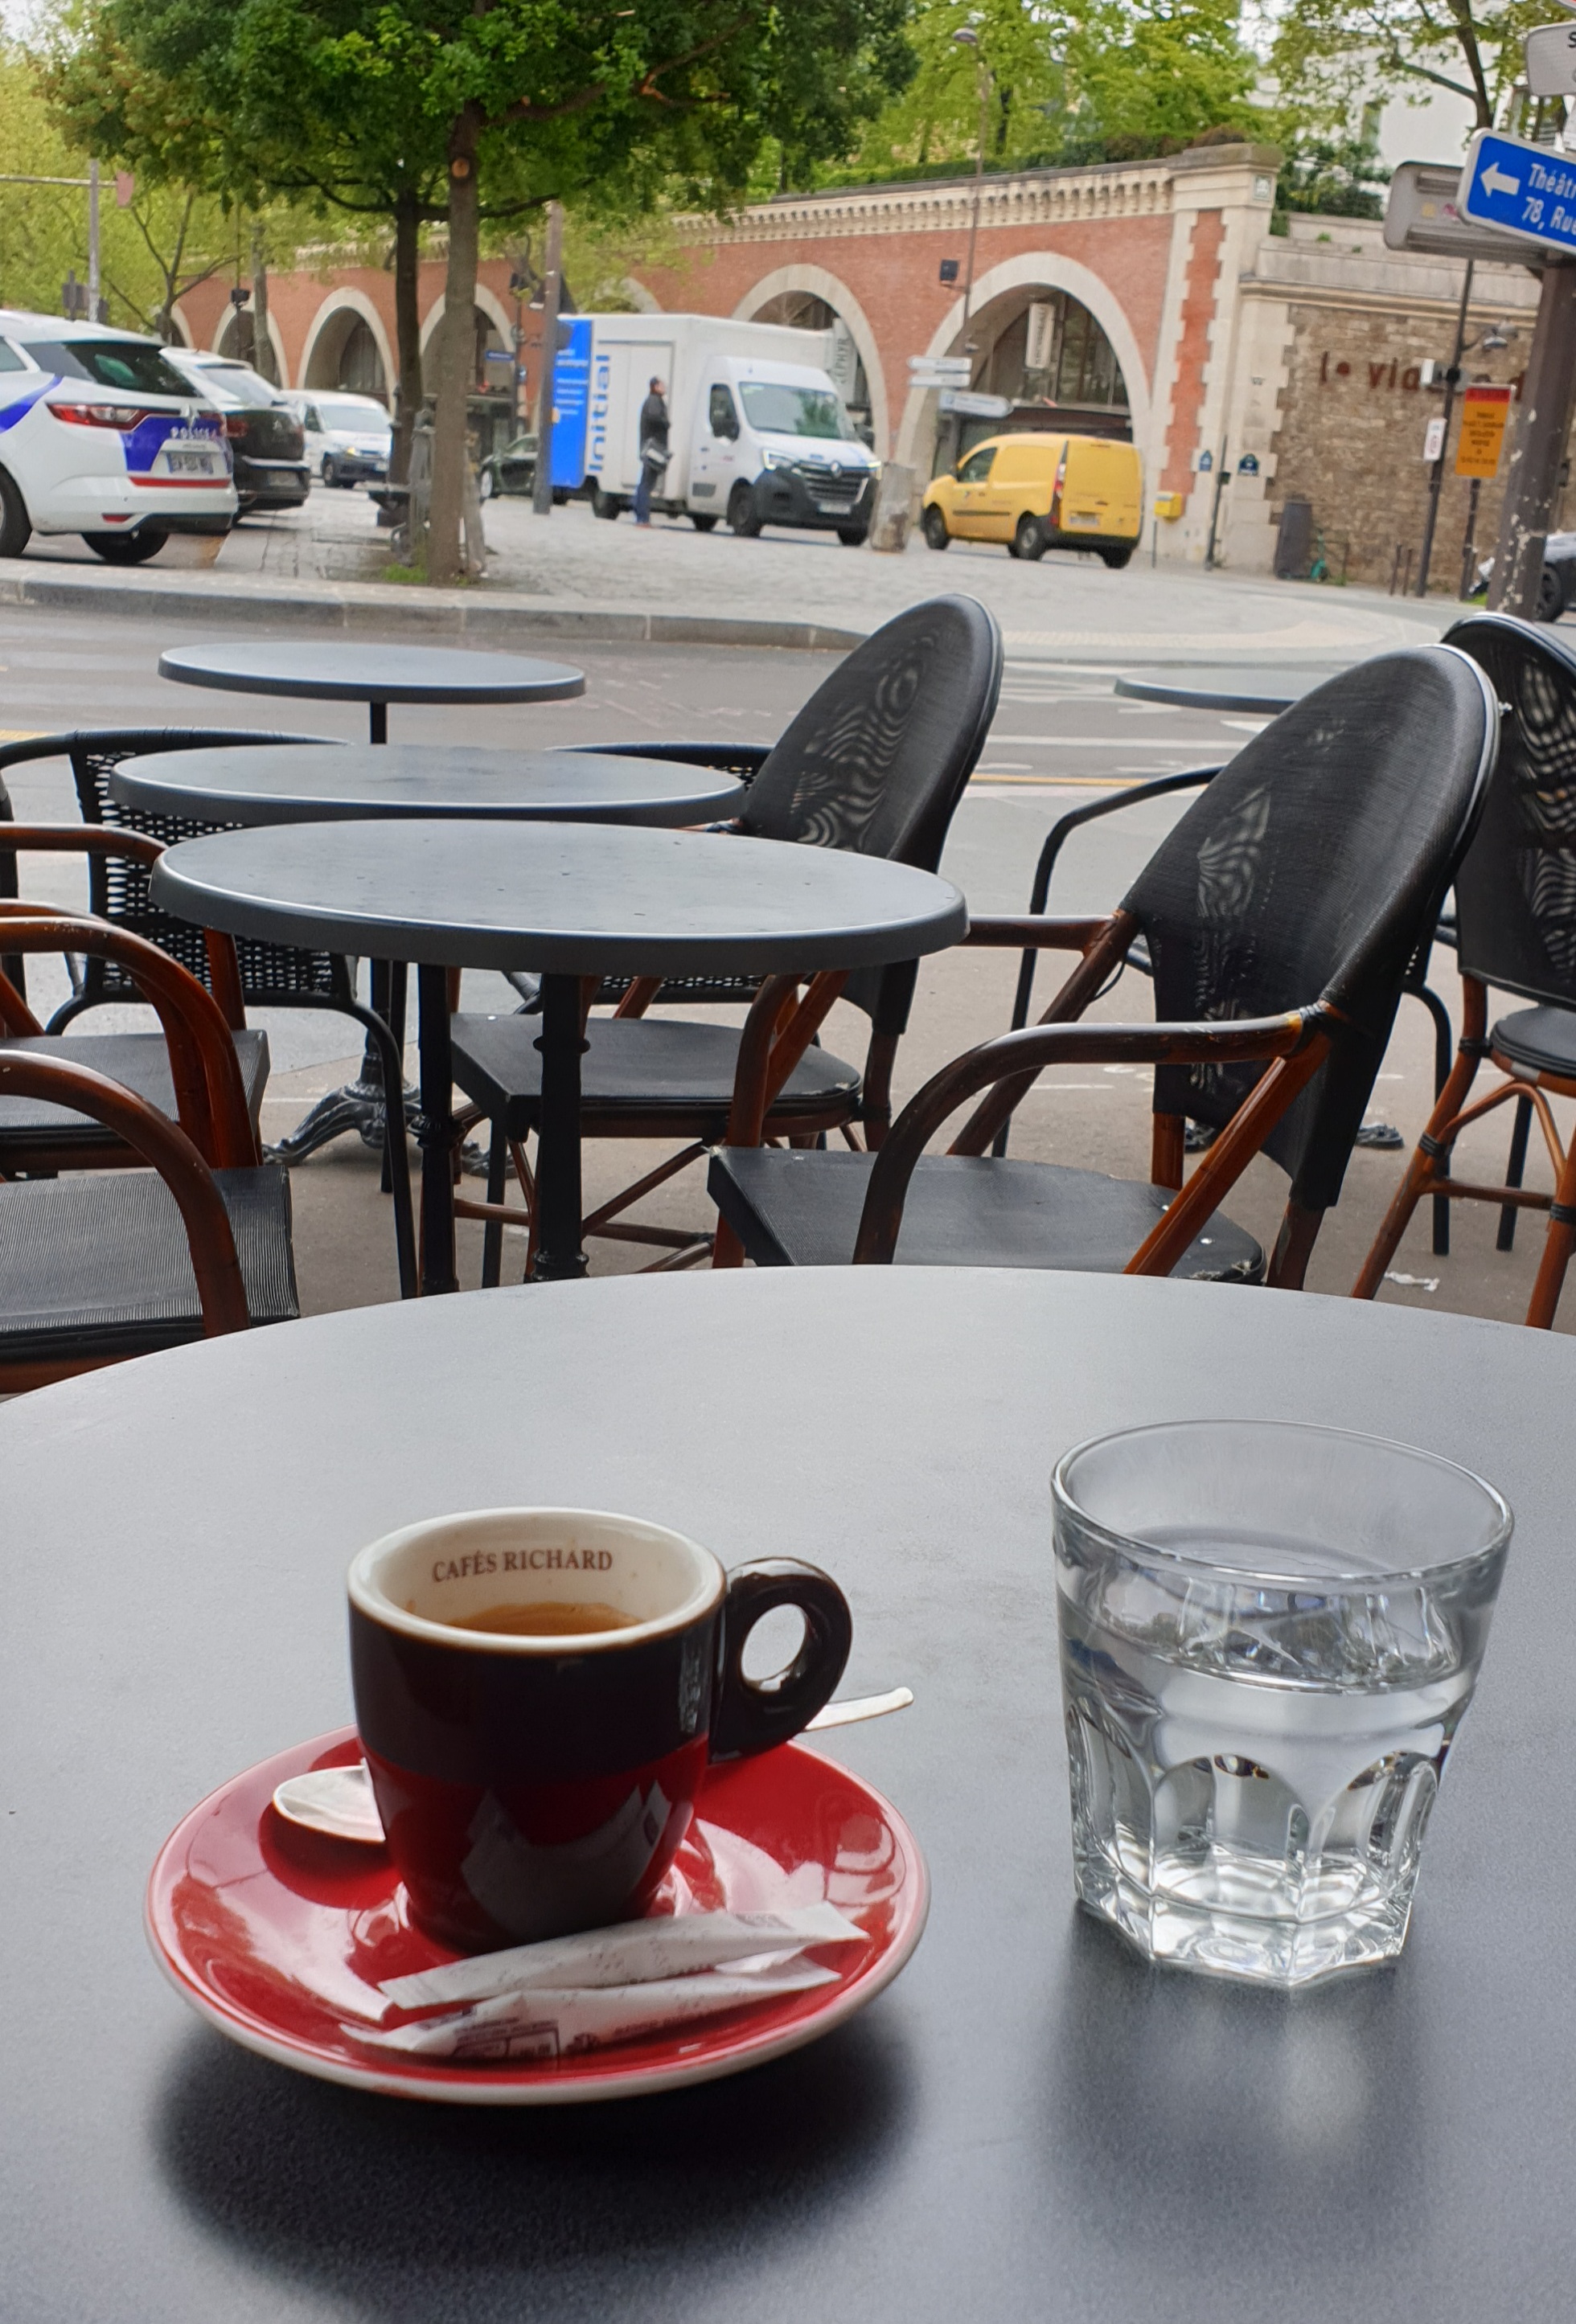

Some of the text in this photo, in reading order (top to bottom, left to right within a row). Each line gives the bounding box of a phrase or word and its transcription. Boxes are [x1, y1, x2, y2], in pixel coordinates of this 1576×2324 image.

[1521, 196, 1545, 232] 78,
[588, 354, 610, 472] Initial
[432, 1548, 613, 1583] CAFÉS RICHARD
